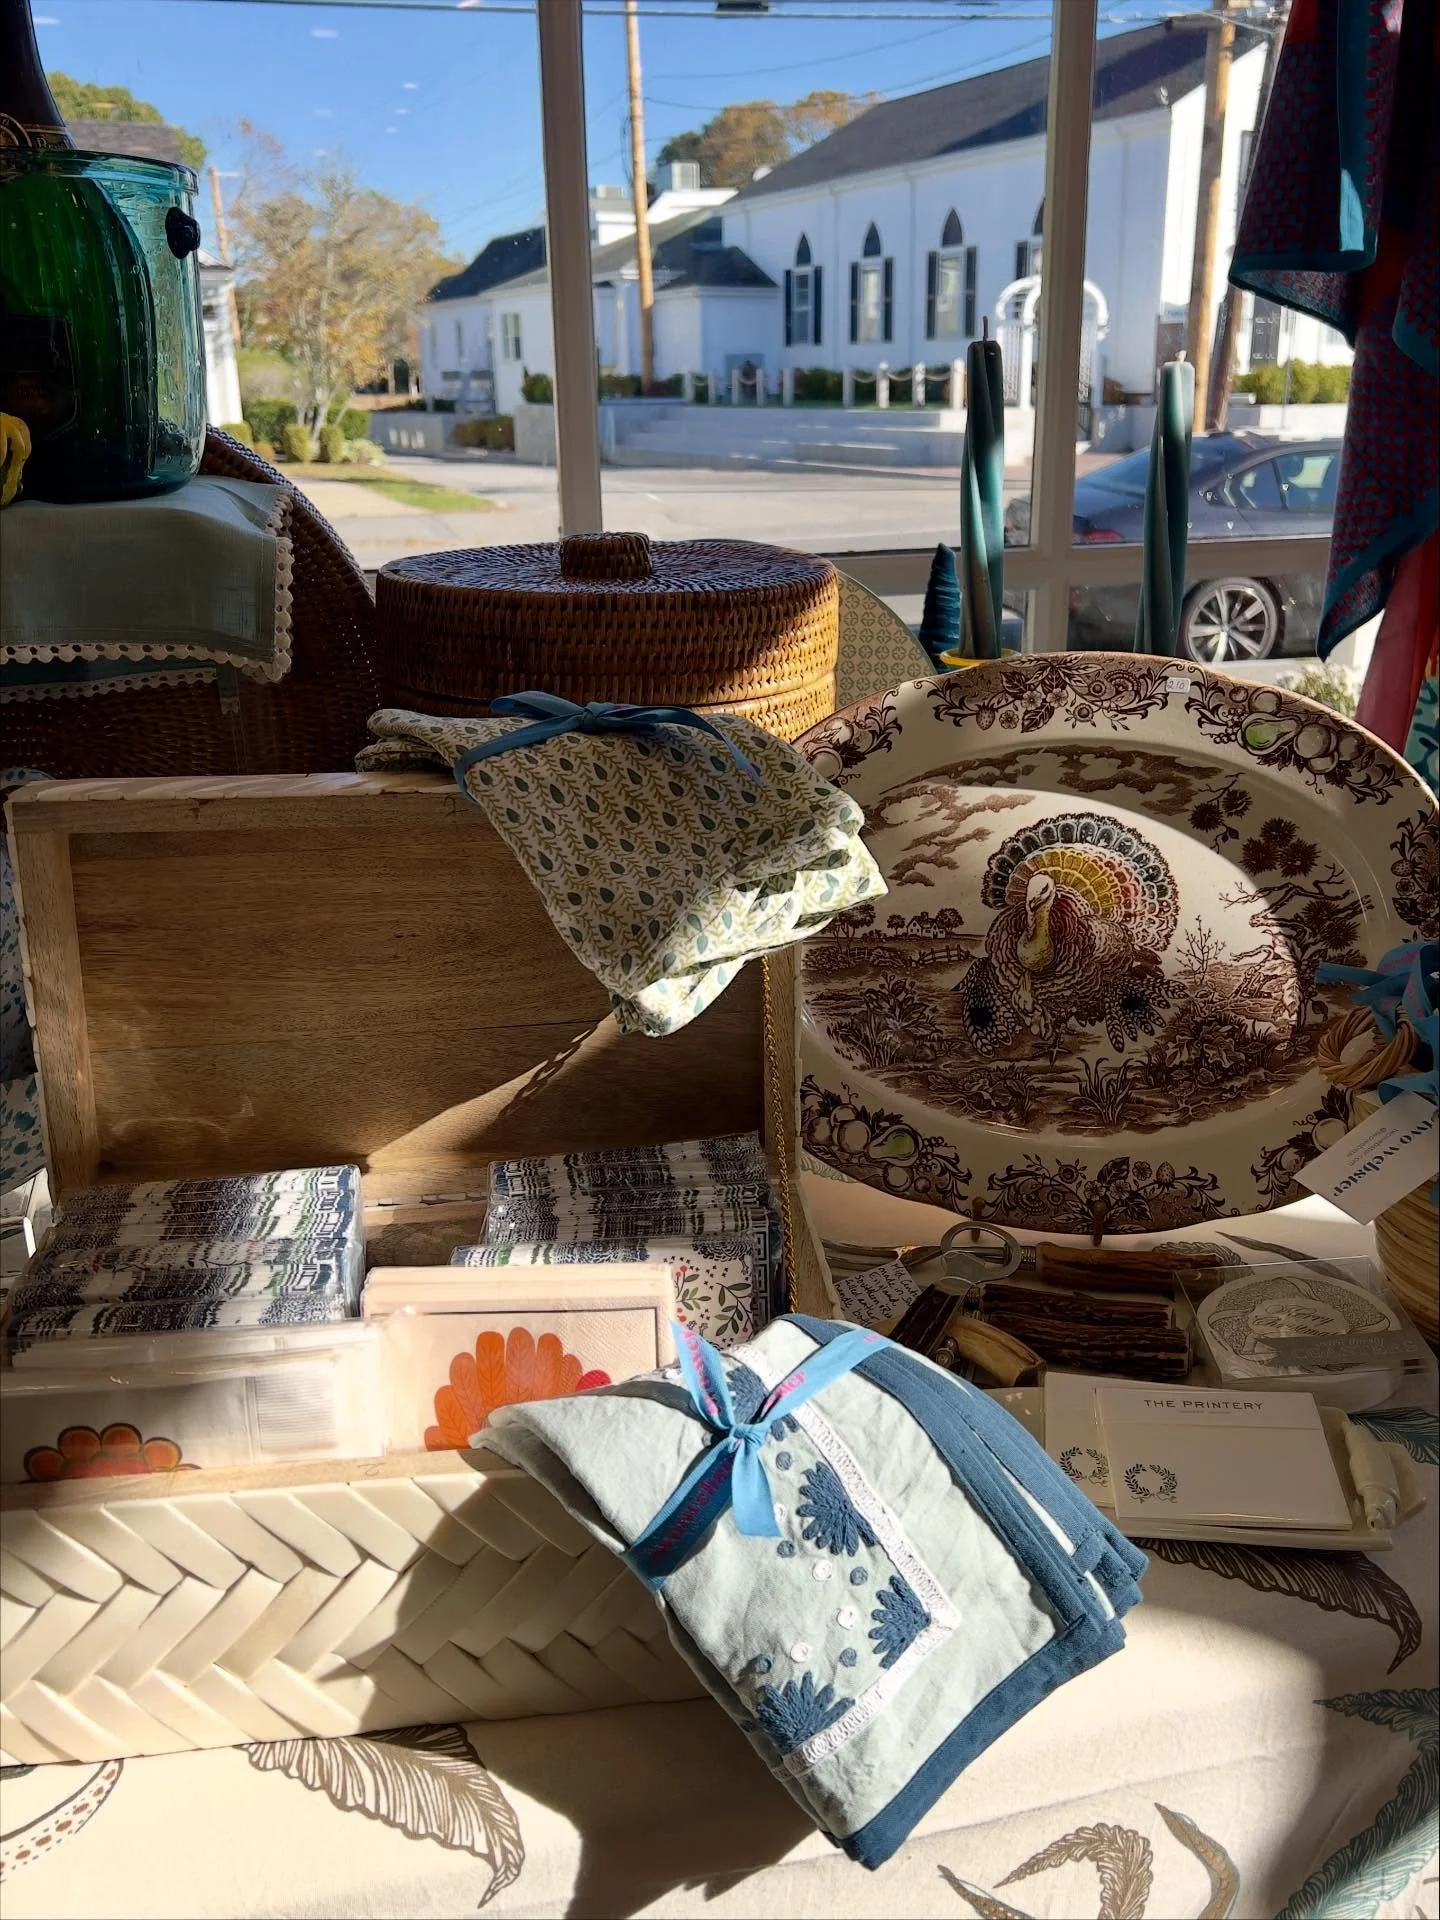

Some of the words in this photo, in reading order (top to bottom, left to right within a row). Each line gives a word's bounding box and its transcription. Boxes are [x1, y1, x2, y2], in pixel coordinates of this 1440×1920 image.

[1333, 1146, 1400, 1197] webster
[1143, 1399, 1176, 1408] THE
[1183, 1401, 1263, 1410] PRINTERY
